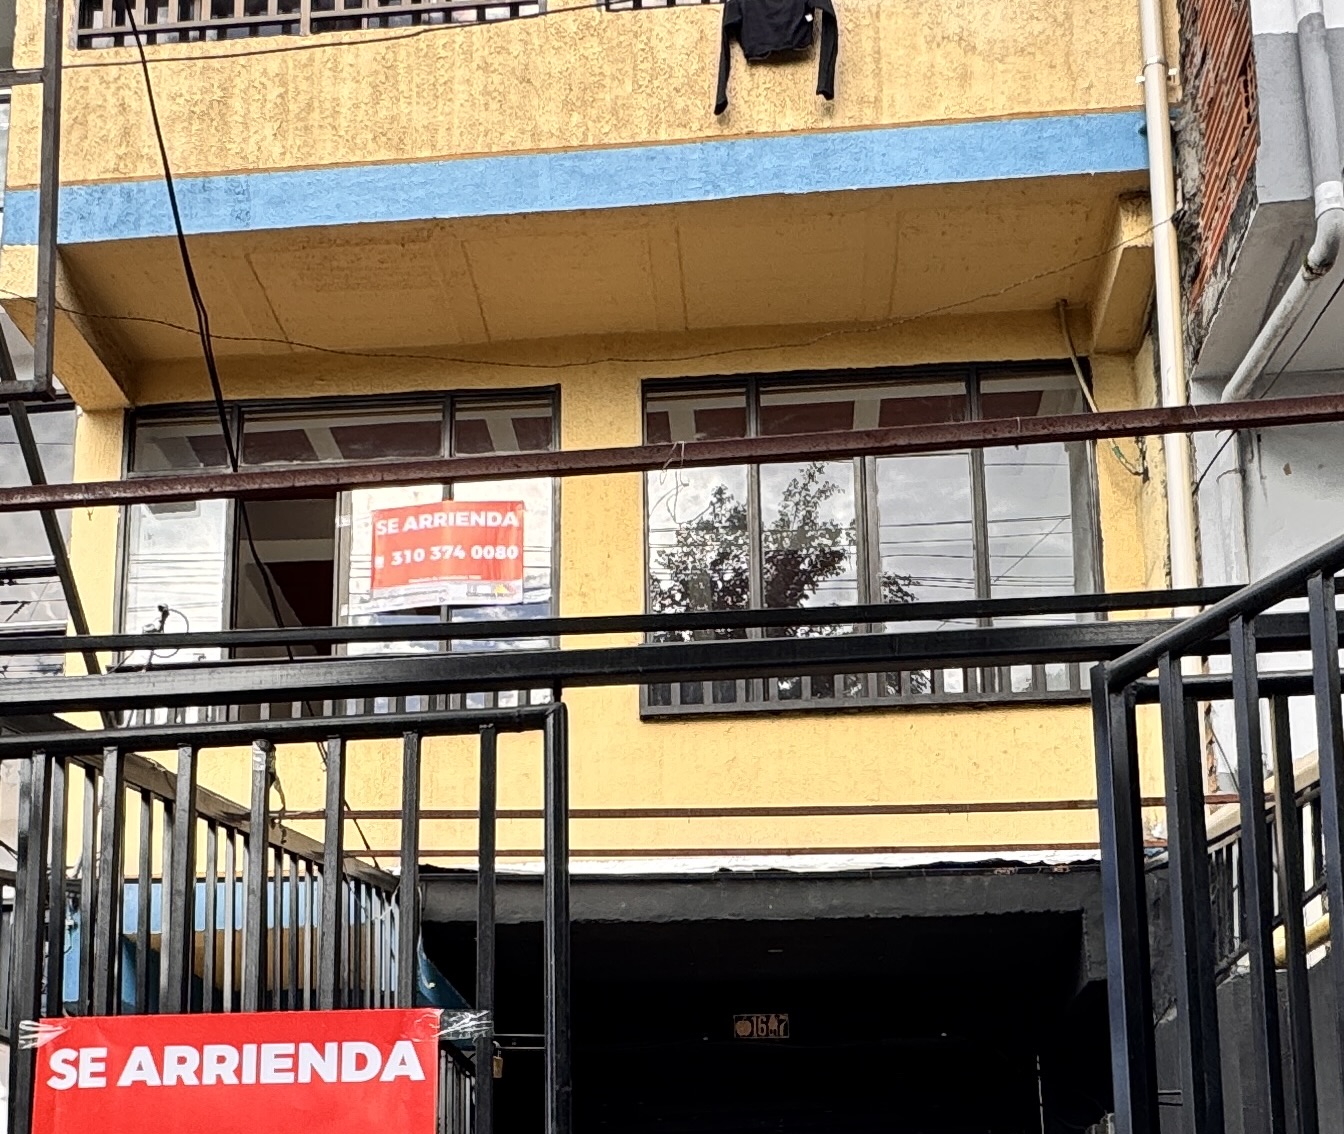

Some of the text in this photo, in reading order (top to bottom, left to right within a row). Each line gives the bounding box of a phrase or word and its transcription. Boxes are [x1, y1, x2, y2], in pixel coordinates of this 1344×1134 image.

[376, 511, 518, 535] SE ARRIENDA
[391, 544, 519, 566] 310 374 0080
[47, 1040, 426, 1090] SE ARRIENDA
